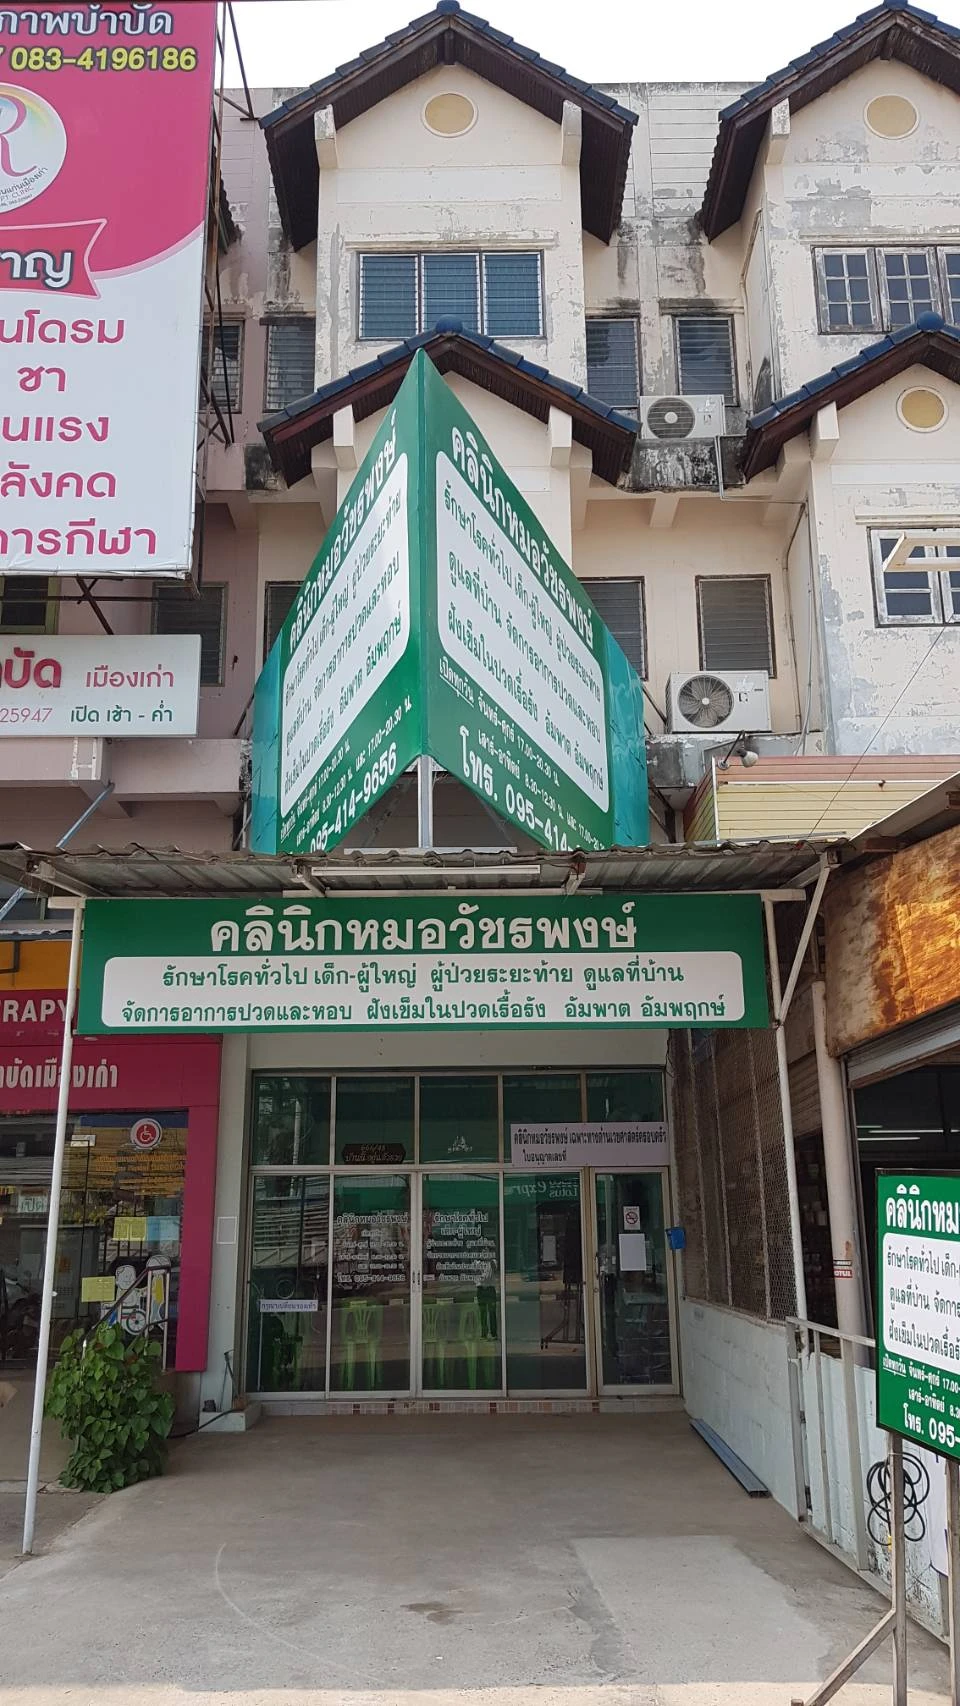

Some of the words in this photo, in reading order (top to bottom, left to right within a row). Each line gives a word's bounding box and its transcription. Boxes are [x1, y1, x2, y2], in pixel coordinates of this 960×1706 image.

[11, 47, 197, 71] 083-4196186
[17, 366, 67, 392] ชา
[2, 416, 110, 441] นแรง
[289, 409, 397, 655] คลินิกหมอวัชรพงษ์
[444, 480, 512, 588] รักษาโรคทั่วไป
[451, 426, 594, 650] คลินิกหมอวัชรพงษ์
[448, 551, 502, 629] ดูแลที่บ้าน
[0, 647, 62, 688] บัด
[86, 664, 174, 688] เมืองเก่า
[70, 705, 100, 722] เปิด
[106, 704, 131, 722] เช้า
[368, 705, 402, 757] 17.00-20.30
[459, 725, 498, 801] โทร.
[310, 741, 397, 853] 095-414-9656
[210, 901, 636, 952] คลินิกหมอวัชรพงษ์
[162, 958, 308, 987] รักษาโรคทั่วไป
[314, 961, 417, 993] เด็ก-ผู้ใหญ่
[430, 959, 573, 991] ผู้ป่วยระยะท้าย
[583, 955, 684, 990] ดูแลที่บ้าน
[121, 1001, 352, 1023] จัดการอาการปวดและหอบ
[367, 989, 546, 1021] ฝังเข็มในปวดเรื้อรัง
[564, 996, 631, 1018] อัมพาต
[640, 994, 726, 1020] อัมพฤกษ์
[887, 1244, 939, 1275] รักษาโรคทั่วไป
[889, 1278, 930, 1310] ดูแลที่บ้าน
[903, 1402, 925, 1435] โทร.
